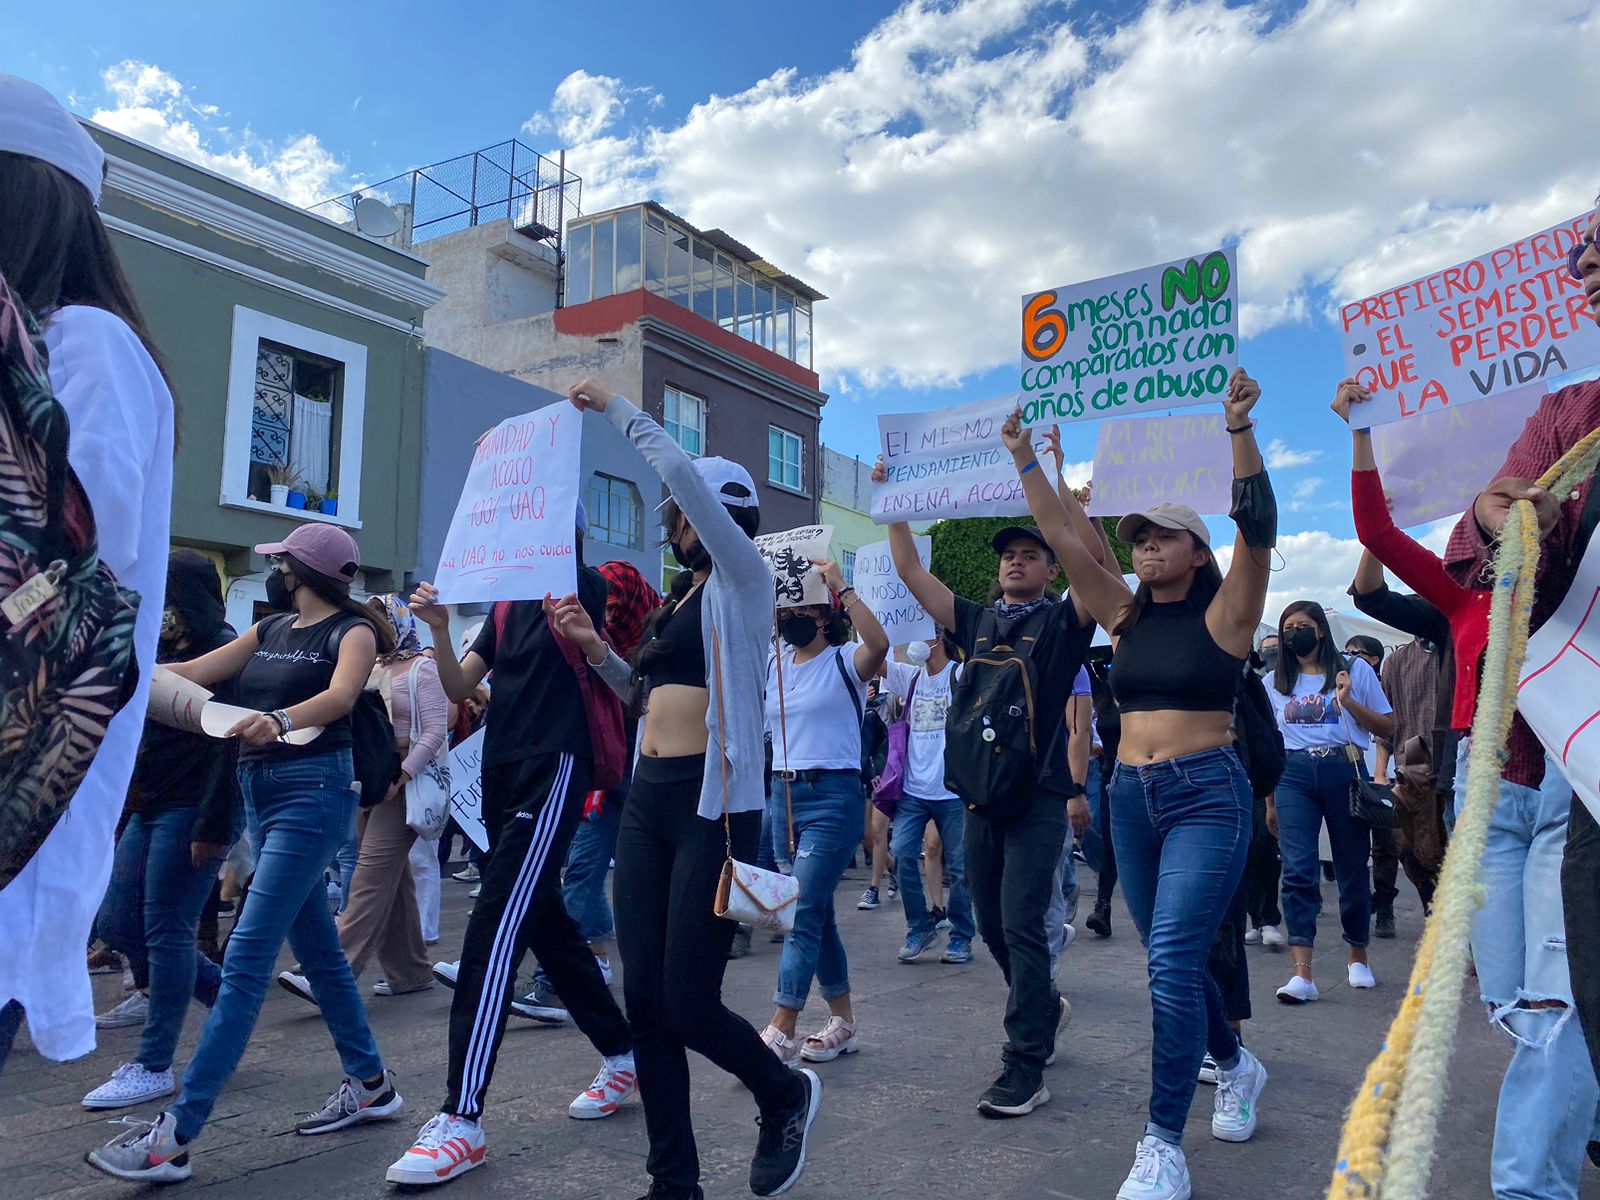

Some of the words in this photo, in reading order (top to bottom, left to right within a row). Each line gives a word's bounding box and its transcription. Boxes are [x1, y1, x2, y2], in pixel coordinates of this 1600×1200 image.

[1342, 260, 1485, 333] PREFIERO
[1490, 213, 1597, 281] PERDE
[1022, 290, 1068, 362] 6
[1067, 283, 1153, 331] meses
[1161, 251, 1230, 311] NO
[1088, 320, 1144, 354] son
[1149, 298, 1232, 338] nada
[1376, 324, 1413, 356] EL
[1436, 264, 1582, 339] SEMESTR
[1021, 337, 1179, 391] comparados
[1183, 333, 1235, 362] con
[1355, 353, 1419, 393] QUE
[1450, 294, 1597, 366] PERDER
[1022, 390, 1084, 424] años
[1091, 378, 1128, 410] de
[1134, 364, 1228, 403] abuso
[1398, 379, 1449, 417] LA
[1470, 345, 1567, 395] VIDA
[549, 414, 560, 448] Y
[886, 432, 911, 458] EL
[921, 418, 993, 450] MISMO
[490, 456, 532, 491] ACOSO
[887, 448, 1000, 483] PENSAMIENTO
[510, 486, 545, 520] UAQ
[883, 486, 958, 513] ENSEÑA,
[968, 479, 1025, 502] ACOSA
[461, 545, 486, 568] UAQ
[492, 550, 505, 562] no
[515, 545, 534, 559] nos
[540, 540, 572, 556] cuida
[874, 555, 891, 573] NO
[871, 582, 910, 600] NOSO
